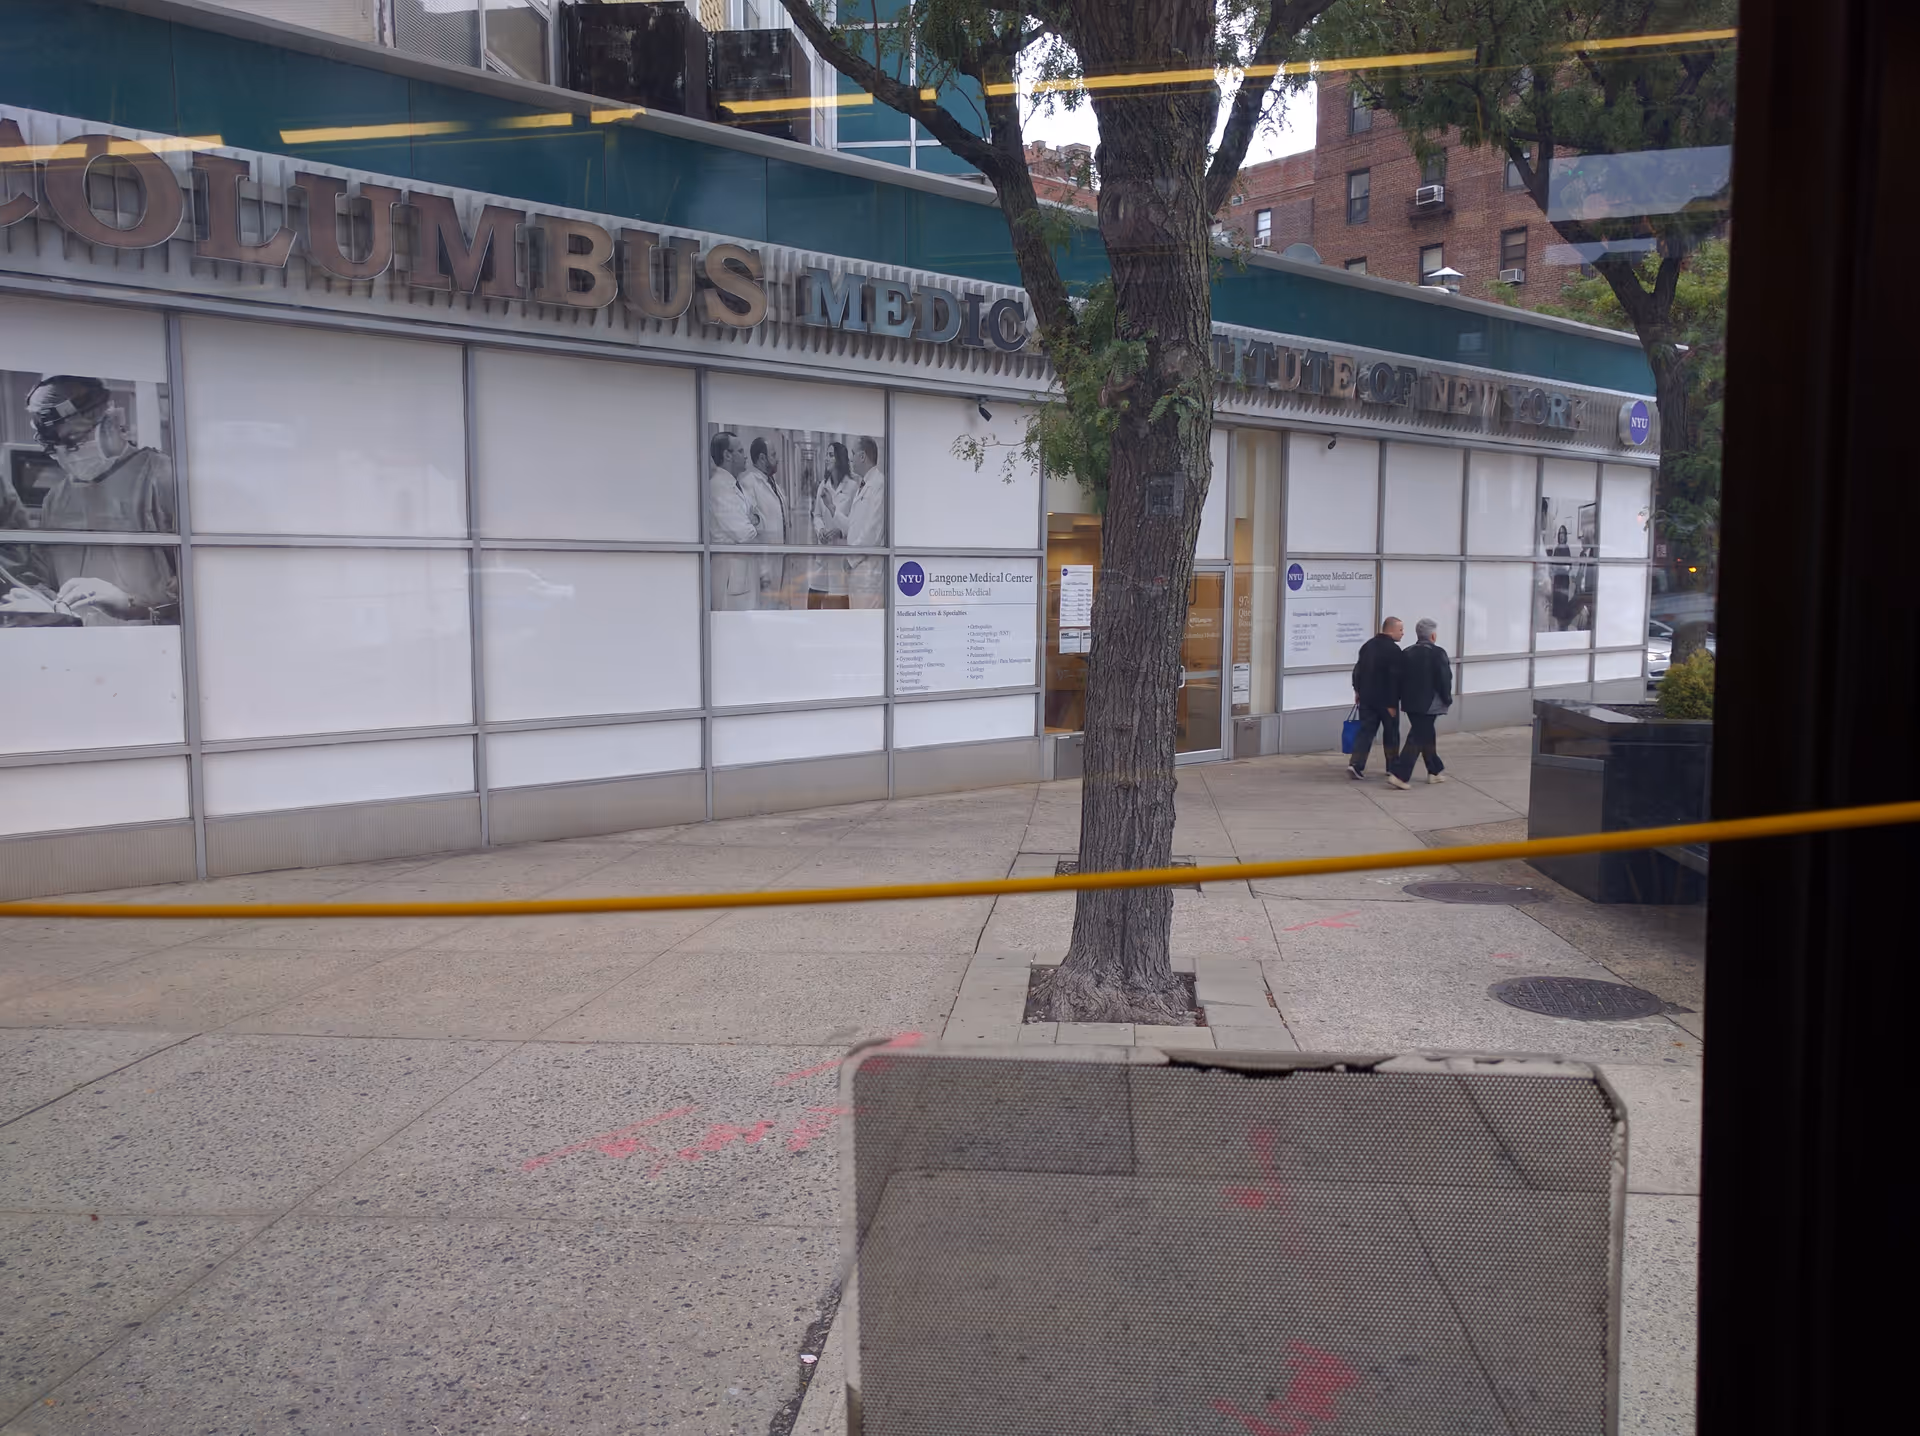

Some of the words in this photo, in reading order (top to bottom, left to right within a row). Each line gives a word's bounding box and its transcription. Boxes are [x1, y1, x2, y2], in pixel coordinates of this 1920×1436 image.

[803, 267, 1027, 352] MEDIC
[1212, 334, 1356, 399] TITUTE
[1367, 362, 1418, 407] OF
[1428, 371, 1499, 417] NEW
[1503, 384, 1589, 431] YORK
[1631, 416, 1648, 430] NYU
[900, 574, 923, 584] NYU
[928, 572, 968, 586] Langone
[969, 572, 1004, 583] Medical
[1005, 573, 1034, 583] Center
[1288, 573, 1303, 581] NYU
[1332, 572, 1354, 580] Medical
[928, 588, 964, 597] Columbus
[965, 587, 991, 597] Medical
